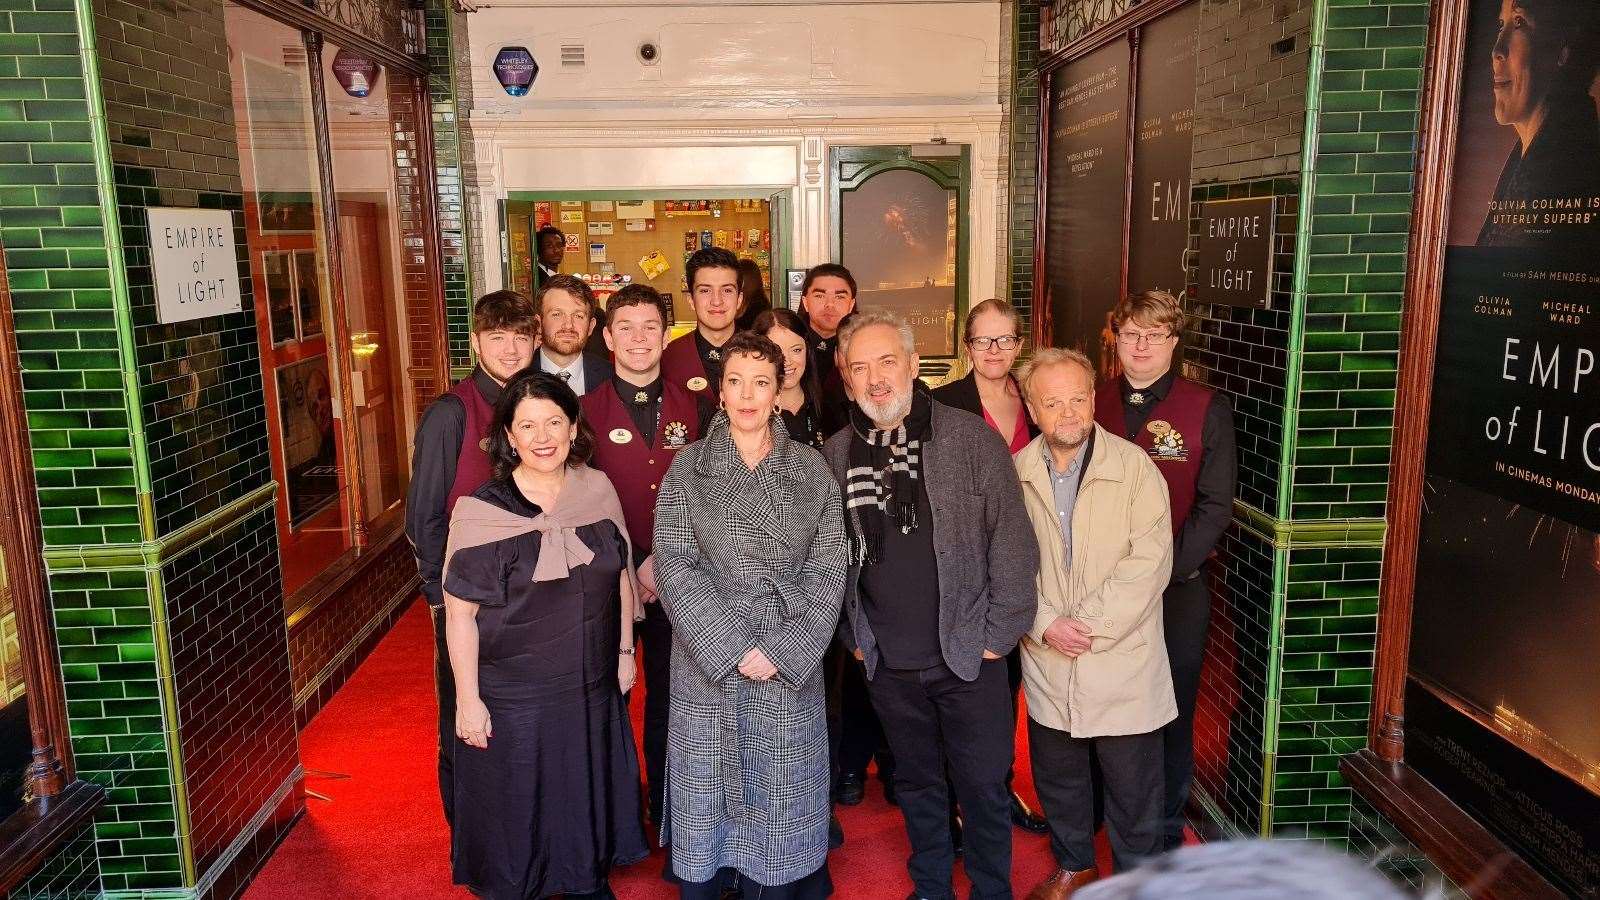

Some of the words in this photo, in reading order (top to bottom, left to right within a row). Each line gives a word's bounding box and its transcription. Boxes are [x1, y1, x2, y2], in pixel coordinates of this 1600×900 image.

[1144, 116, 1161, 128] OLIVIA
[1141, 128, 1162, 141] COLMAN
[1532, 198, 1581, 208] COLMAN
[1588, 197, 1600, 208] IS
[1494, 214, 1538, 224] UTTERLY
[1544, 212, 1596, 224] SUPERB"
[1209, 216, 1260, 238] EMPIRE
[165, 228, 224, 248] EMPIRE
[1226, 242, 1238, 262] of
[192, 252, 204, 273] of
[1210, 268, 1253, 291] LIGHT
[1528, 270, 1546, 280] SAM
[1550, 271, 1587, 282] MENDES
[177, 279, 224, 304] LIGHT
[1478, 295, 1511, 306] OLIVIA
[1542, 301, 1591, 314] MICHEAL
[1474, 305, 1512, 316] COLMAN
[1550, 313, 1581, 325] WARD
[1502, 338, 1595, 393] EMP
[1486, 406, 1520, 445] of
[1495, 461, 1505, 472] IN
[1508, 465, 1552, 488] CINEMAS
[1555, 481, 1600, 504] MONDAY
